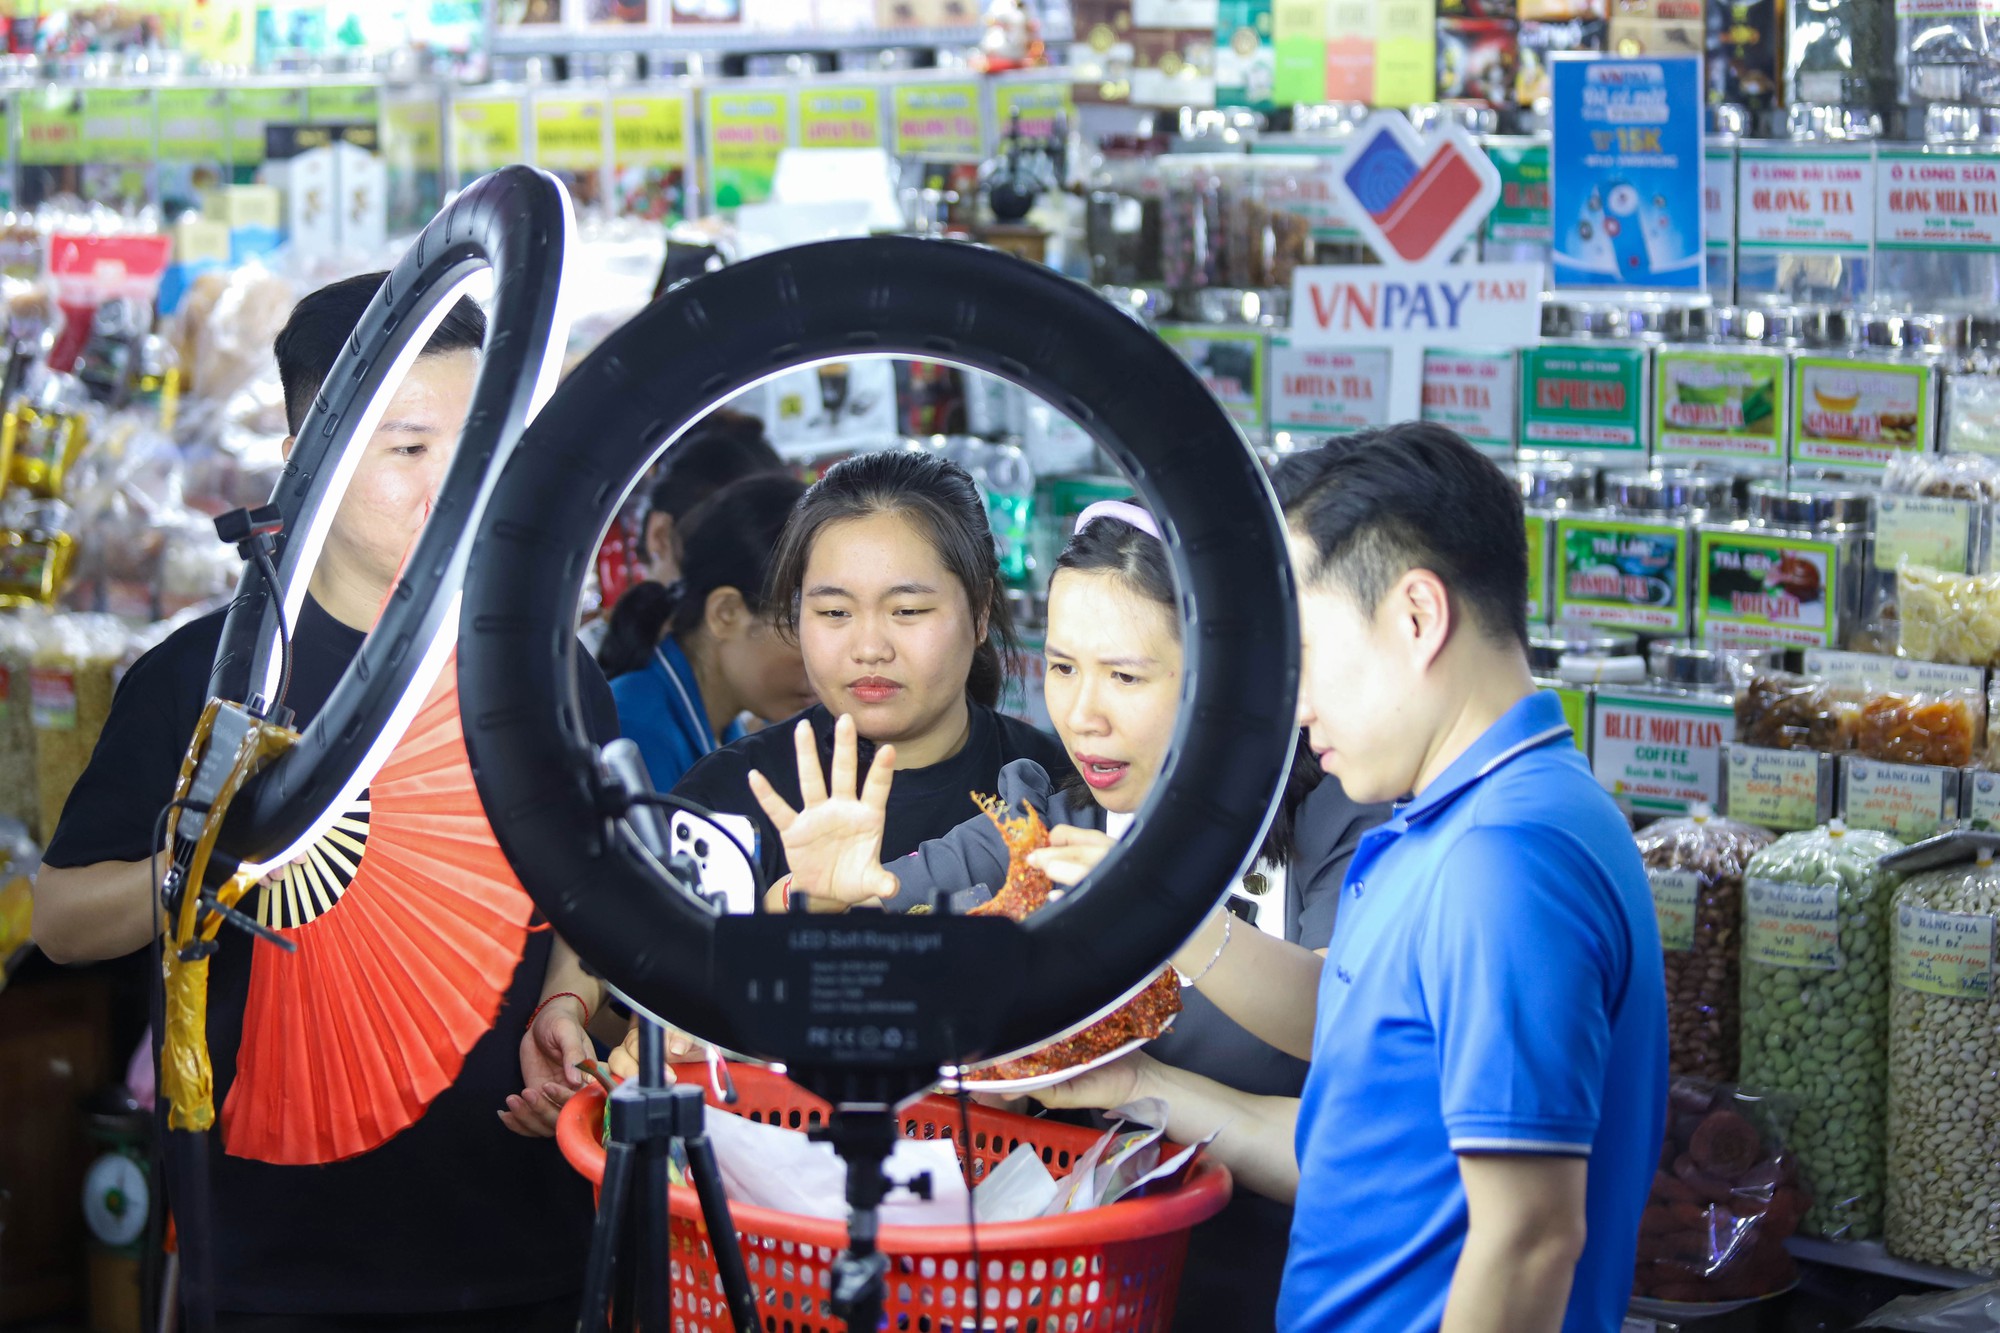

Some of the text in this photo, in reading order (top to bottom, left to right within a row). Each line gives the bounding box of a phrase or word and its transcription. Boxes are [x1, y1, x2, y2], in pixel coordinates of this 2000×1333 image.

[1892, 163, 1903, 180] Ô
[1909, 166, 1955, 181] LONG
[1753, 189, 1854, 214] OLONG TEA
[1889, 189, 1998, 215] OLONG MILK TEA
[1309, 280, 1527, 330] VNPAY TAXI
[1342, 377, 1373, 399] TEA
[1463, 385, 1491, 409] TEA
[1536, 377, 1626, 412] ESPRESSO
[1722, 405, 1744, 427] TEA
[1859, 412, 1882, 436] TEA
[1593, 537, 1618, 555] TRÀ
[1715, 551, 1771, 571] TRÀ SEN
[1570, 572, 1649, 599] JASMINE TEA
[1732, 590, 1801, 619] LOTUS TEA
[1604, 711, 1723, 748] BLUE MOUTAIN
[1634, 745, 1689, 766] COFFEE
[1876, 767, 1931, 784] BẢNG GIÁ
[1918, 917, 1978, 934] BẢNG GIÁ
[789, 930, 826, 949] LED
